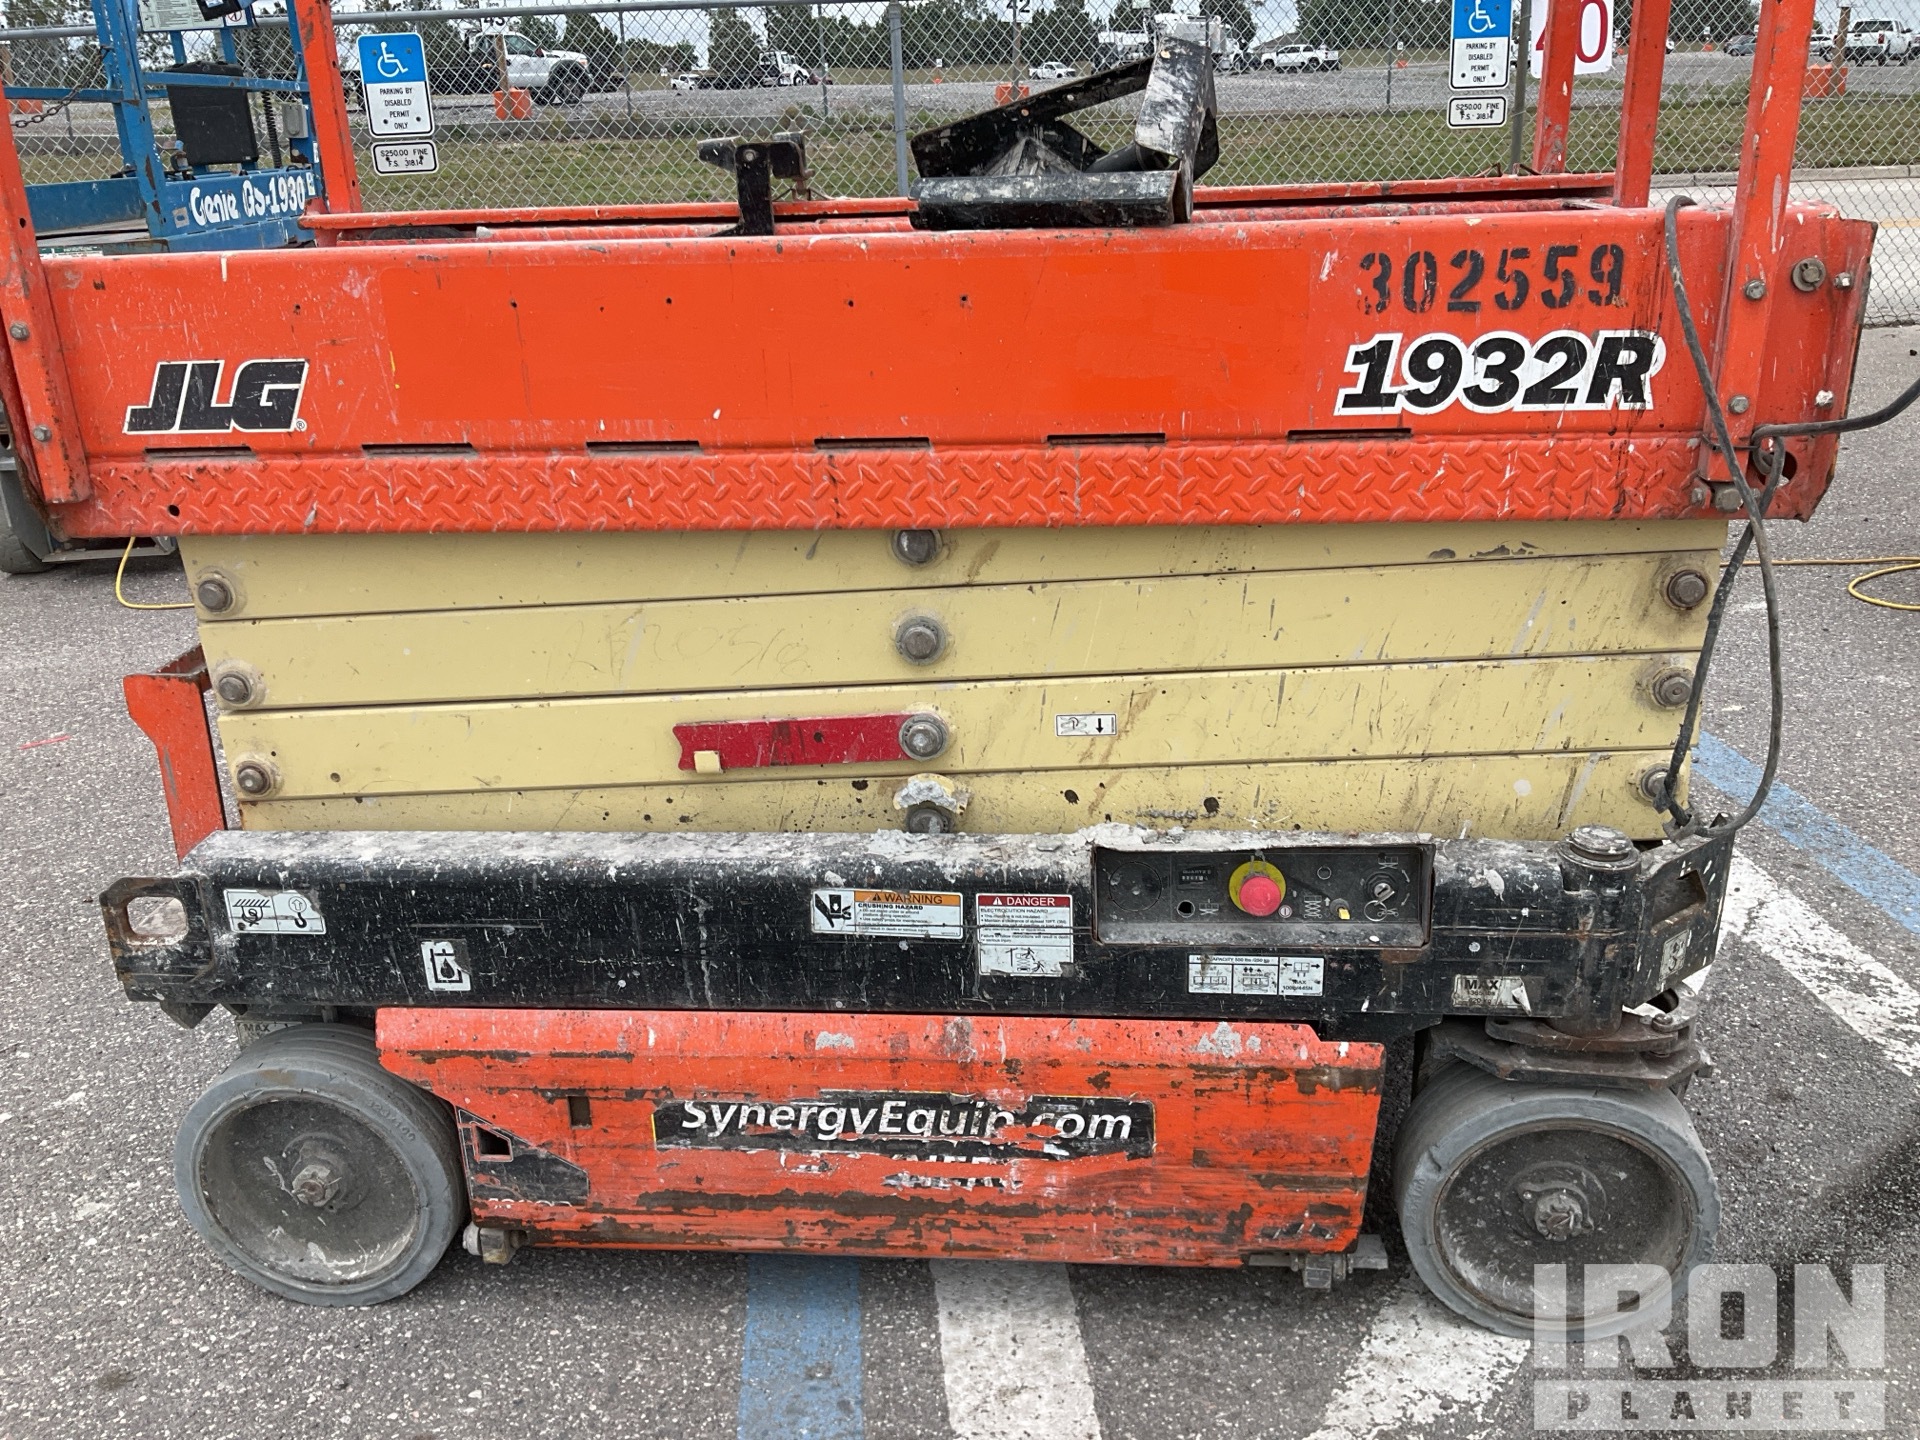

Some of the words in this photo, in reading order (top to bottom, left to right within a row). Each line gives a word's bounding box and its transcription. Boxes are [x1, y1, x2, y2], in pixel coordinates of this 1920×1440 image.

[1535, 0, 1609, 64] 0
[1468, 53, 1494, 61] DISABLED
[1470, 64, 1490, 72] PERMIT
[384, 99, 412, 107] DISABLED
[389, 110, 410, 118] PERMIT
[394, 122, 409, 130] ONLY
[413, 148, 429, 156] FINE
[190, 187, 239, 226] Genie
[1358, 244, 1625, 315] 302559
[1336, 331, 1664, 414] 1932R
[123, 358, 309, 434] JLG
[884, 893, 943, 905] WARNING
[1006, 897, 1056, 906] DANGER
[243, 1024, 270, 1032] MAX
